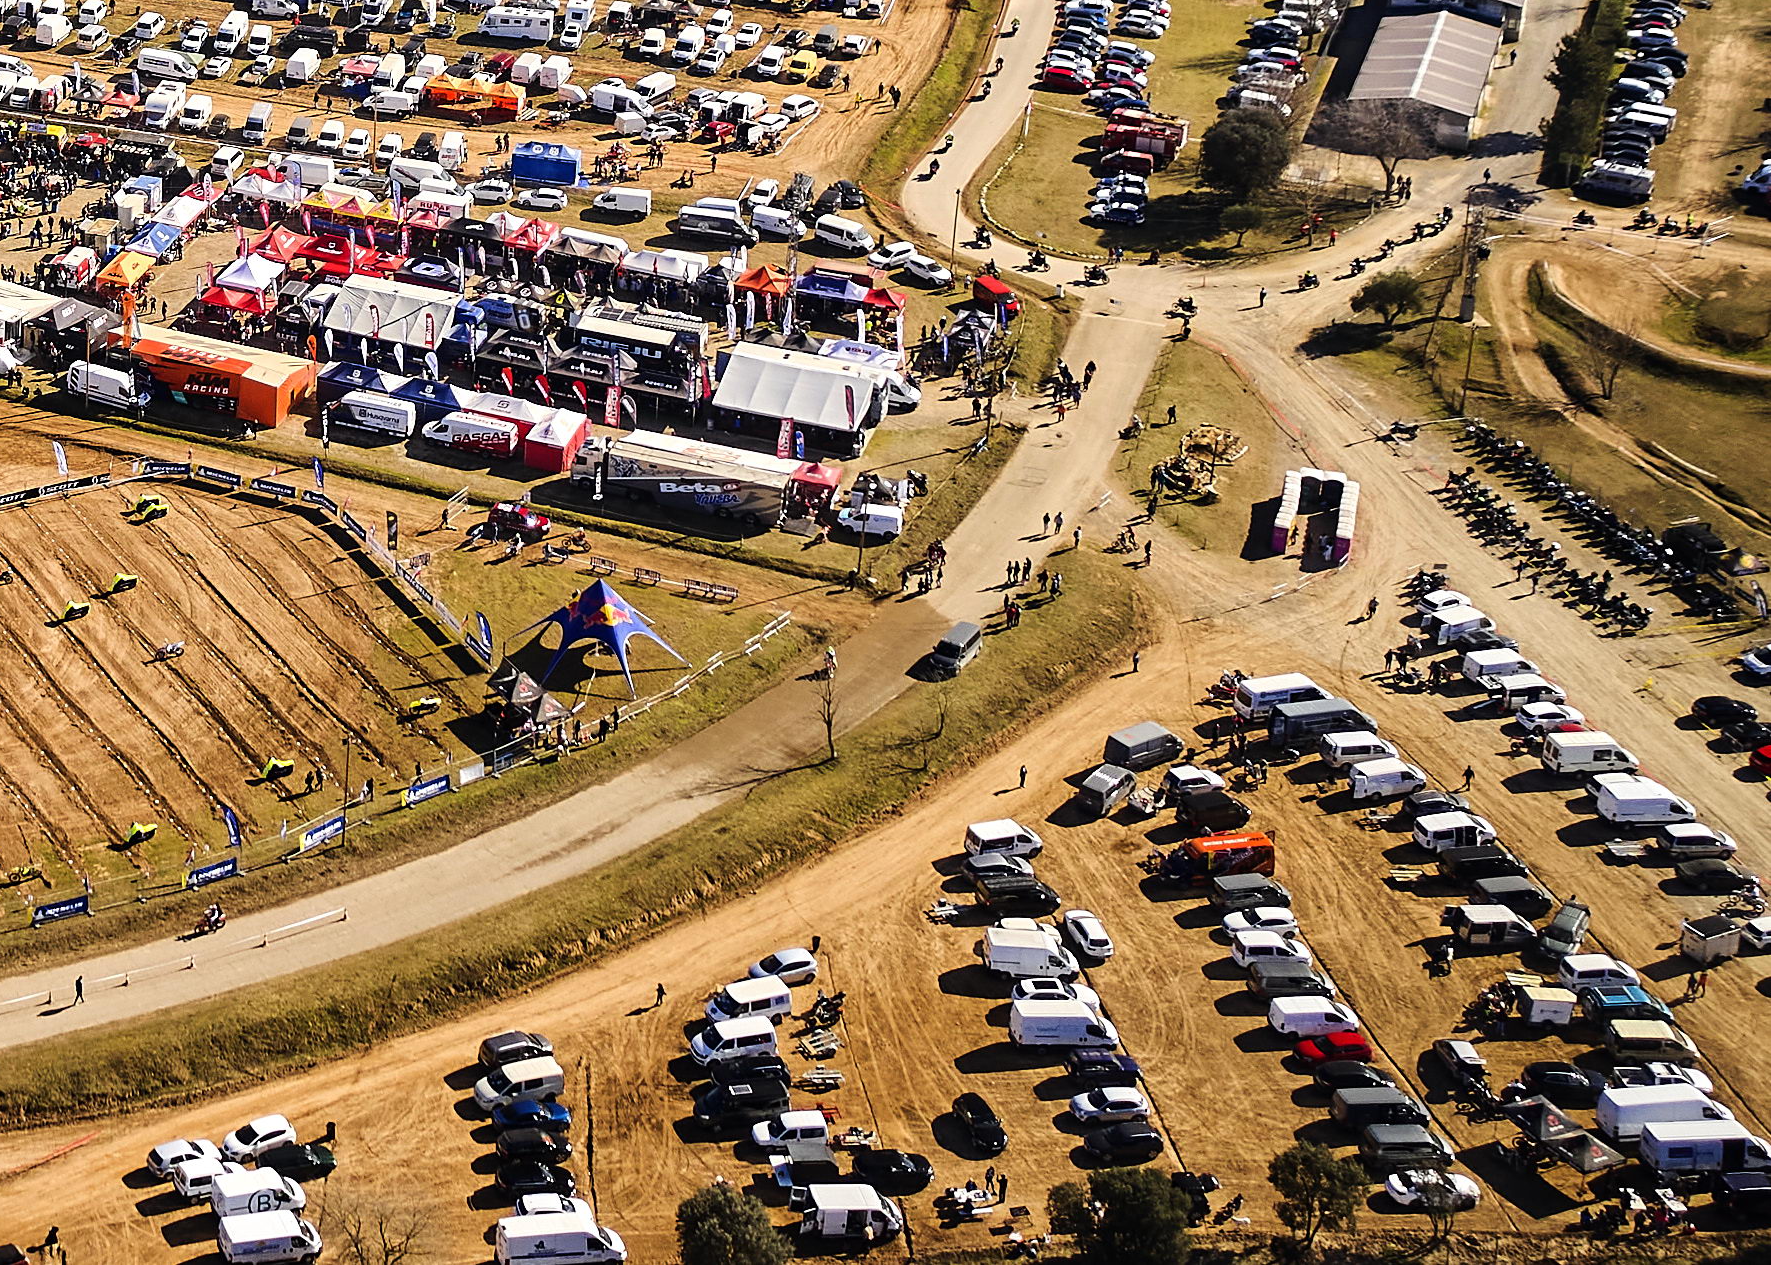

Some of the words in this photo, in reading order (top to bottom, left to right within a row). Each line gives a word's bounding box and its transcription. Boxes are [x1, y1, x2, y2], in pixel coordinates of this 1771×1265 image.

[580, 336, 662, 359] RIEJU
[183, 383, 229, 395] RACING
[451, 431, 511, 443] GASGAS
[46, 480, 80, 493] SCOTT
[659, 482, 722, 493] Beta
[257, 1194, 271, 1213] B
